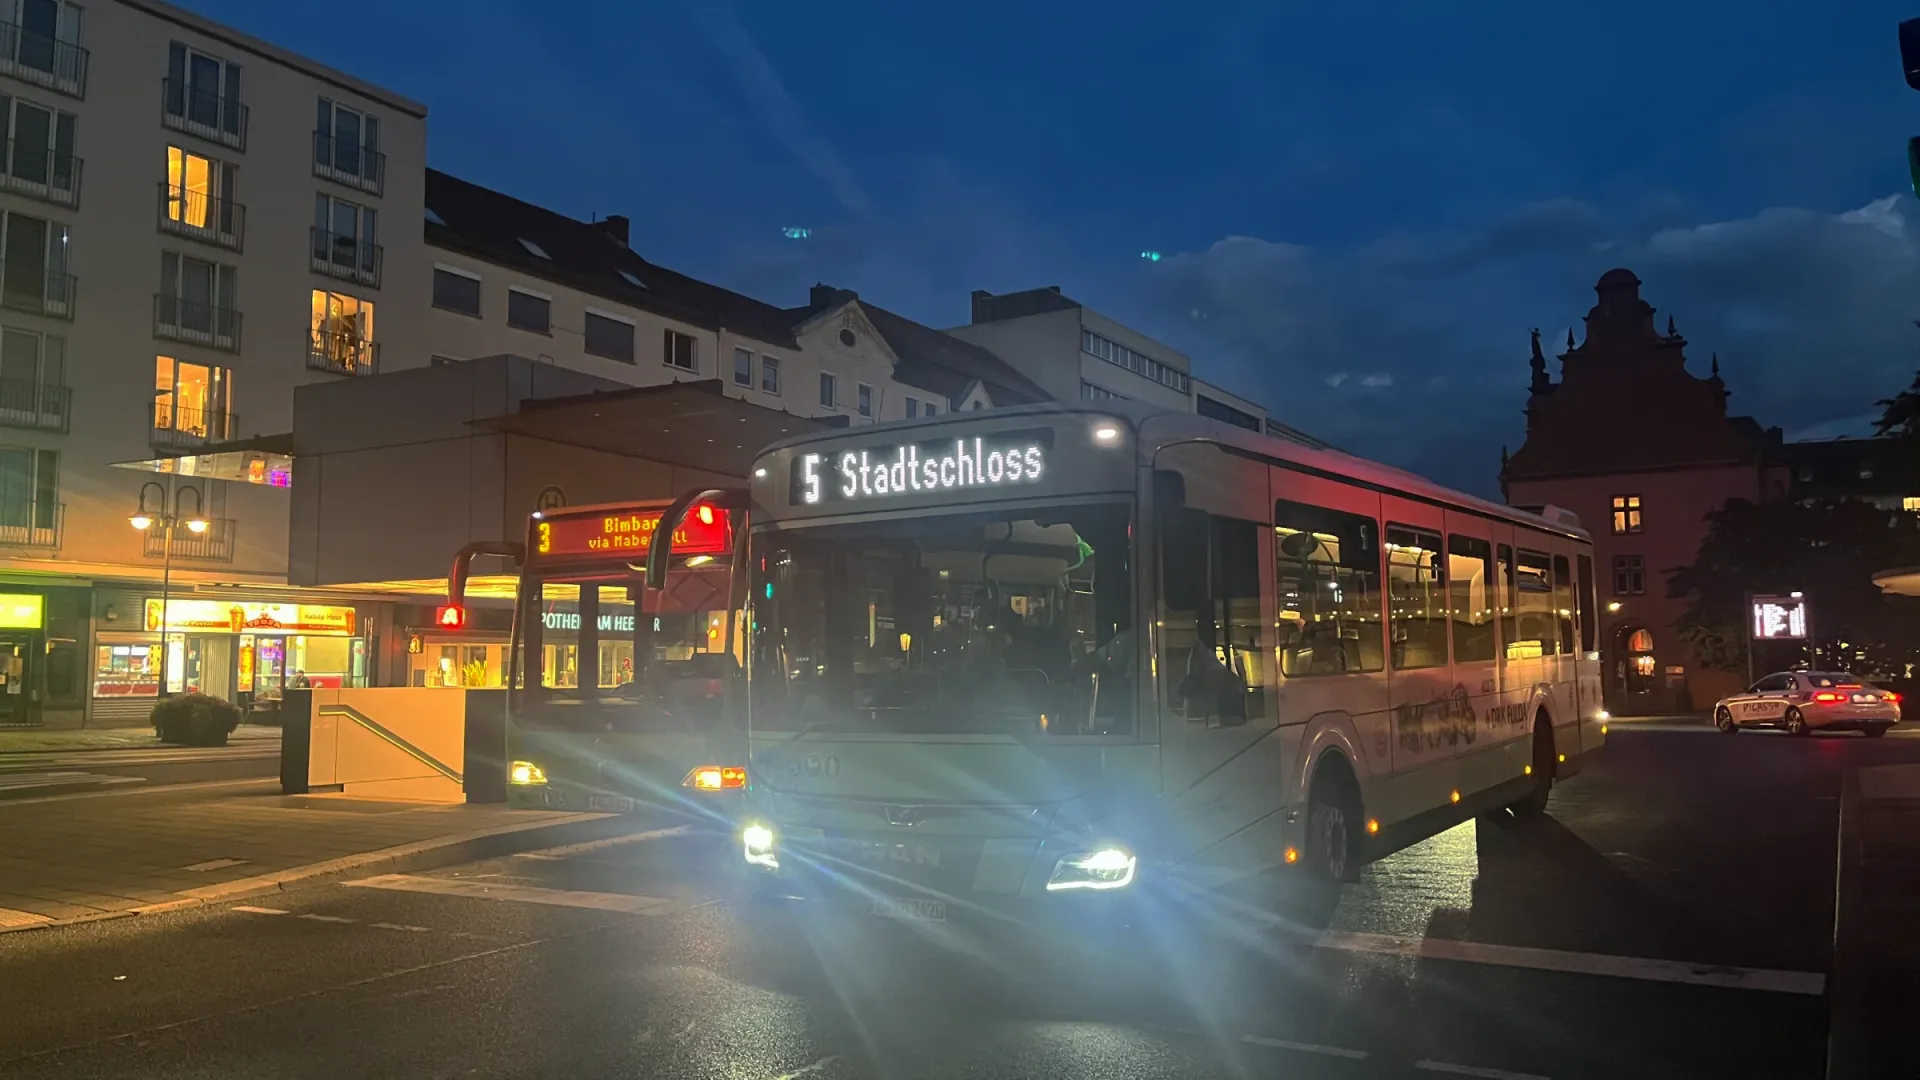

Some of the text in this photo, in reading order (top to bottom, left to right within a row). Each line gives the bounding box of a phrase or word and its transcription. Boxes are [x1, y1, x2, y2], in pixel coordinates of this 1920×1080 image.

[804, 437, 1043, 502] 5 Stadtschloss
[539, 522, 550, 552] 3
[589, 536, 609, 549] via
[1743, 702, 1779, 713] PICASSO
